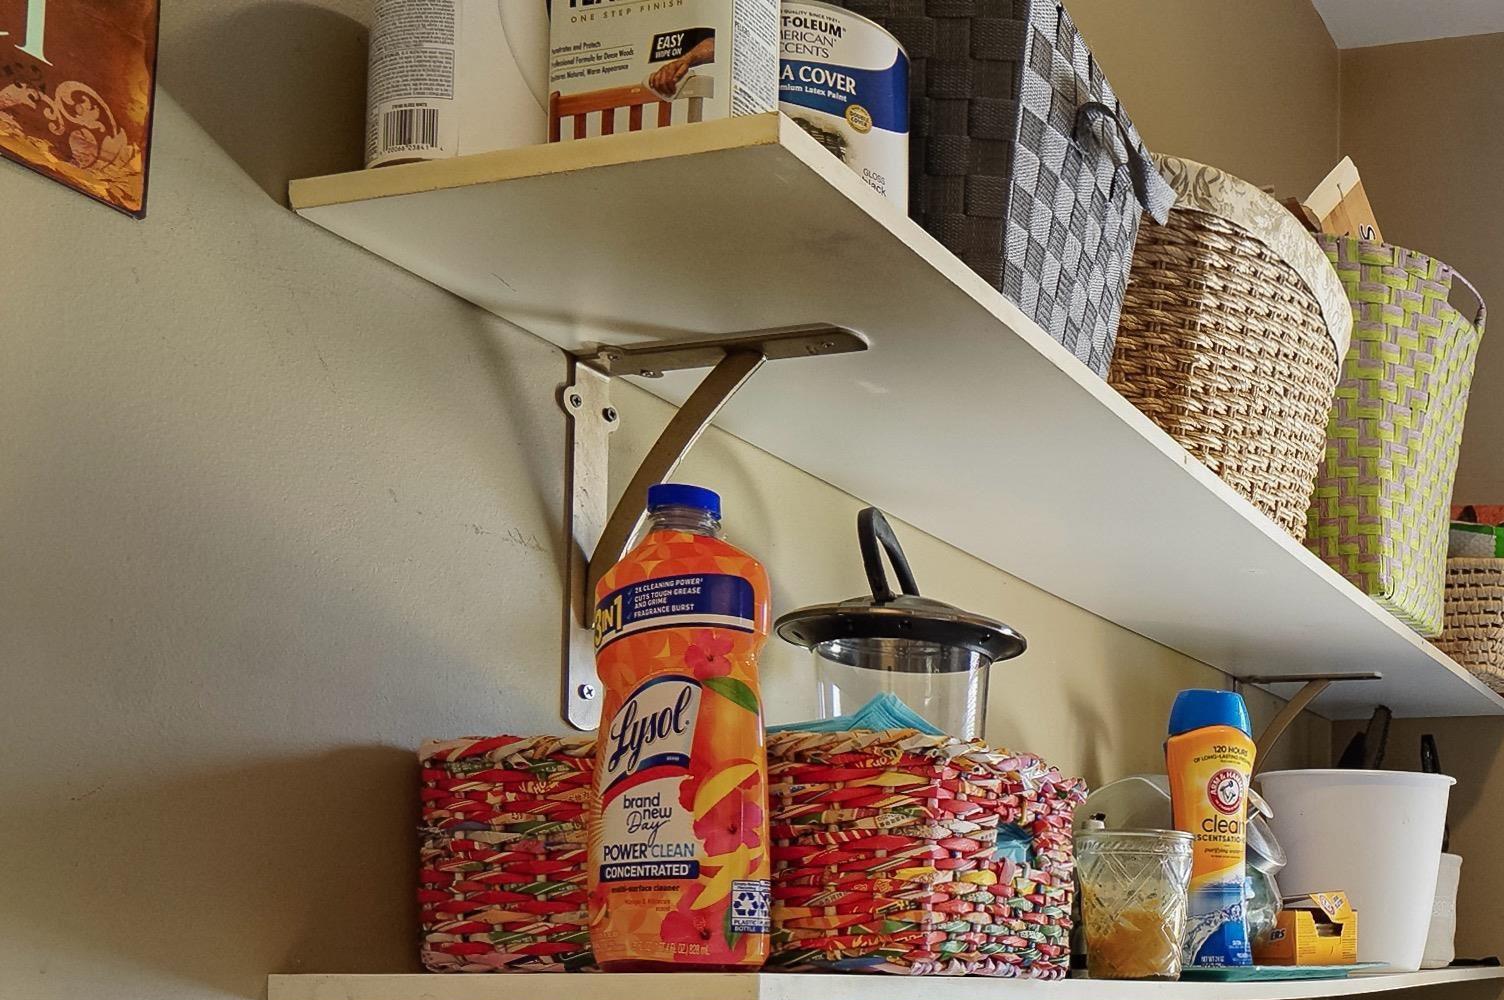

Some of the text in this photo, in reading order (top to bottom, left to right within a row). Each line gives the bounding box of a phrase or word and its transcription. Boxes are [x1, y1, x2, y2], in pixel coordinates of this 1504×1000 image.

[571, 12, 595, 24] ONE
[603, 8, 632, 19] STEP
[640, 0, 683, 13] FINISH
[781, 16, 842, 38] T-OLEUM
[656, 33, 685, 50] EASY
[780, 29, 834, 47] ERICAN
[672, 47, 682, 56] ON
[798, 65, 856, 95] COVER
[805, 86, 826, 96] Latex
[827, 91, 847, 102] Paint
[863, 168, 886, 186] GLOSS
[643, 580, 675, 591] CLEANING
[634, 587, 701, 603] CUTS TOUGH GREASE
[647, 597, 667, 606] GRIME
[633, 603, 695, 618] FRAGRANCE BURST
[608, 685, 692, 772] Lysol
[1213, 745, 1248, 757] 120 HOURS
[623, 792, 660, 809] brand
[643, 807, 672, 820] new
[626, 811, 671, 848] Day
[603, 843, 695, 861] POWER CLEAN
[605, 864, 689, 879] CONCENTRATED
[653, 884, 680, 892] cleaner
